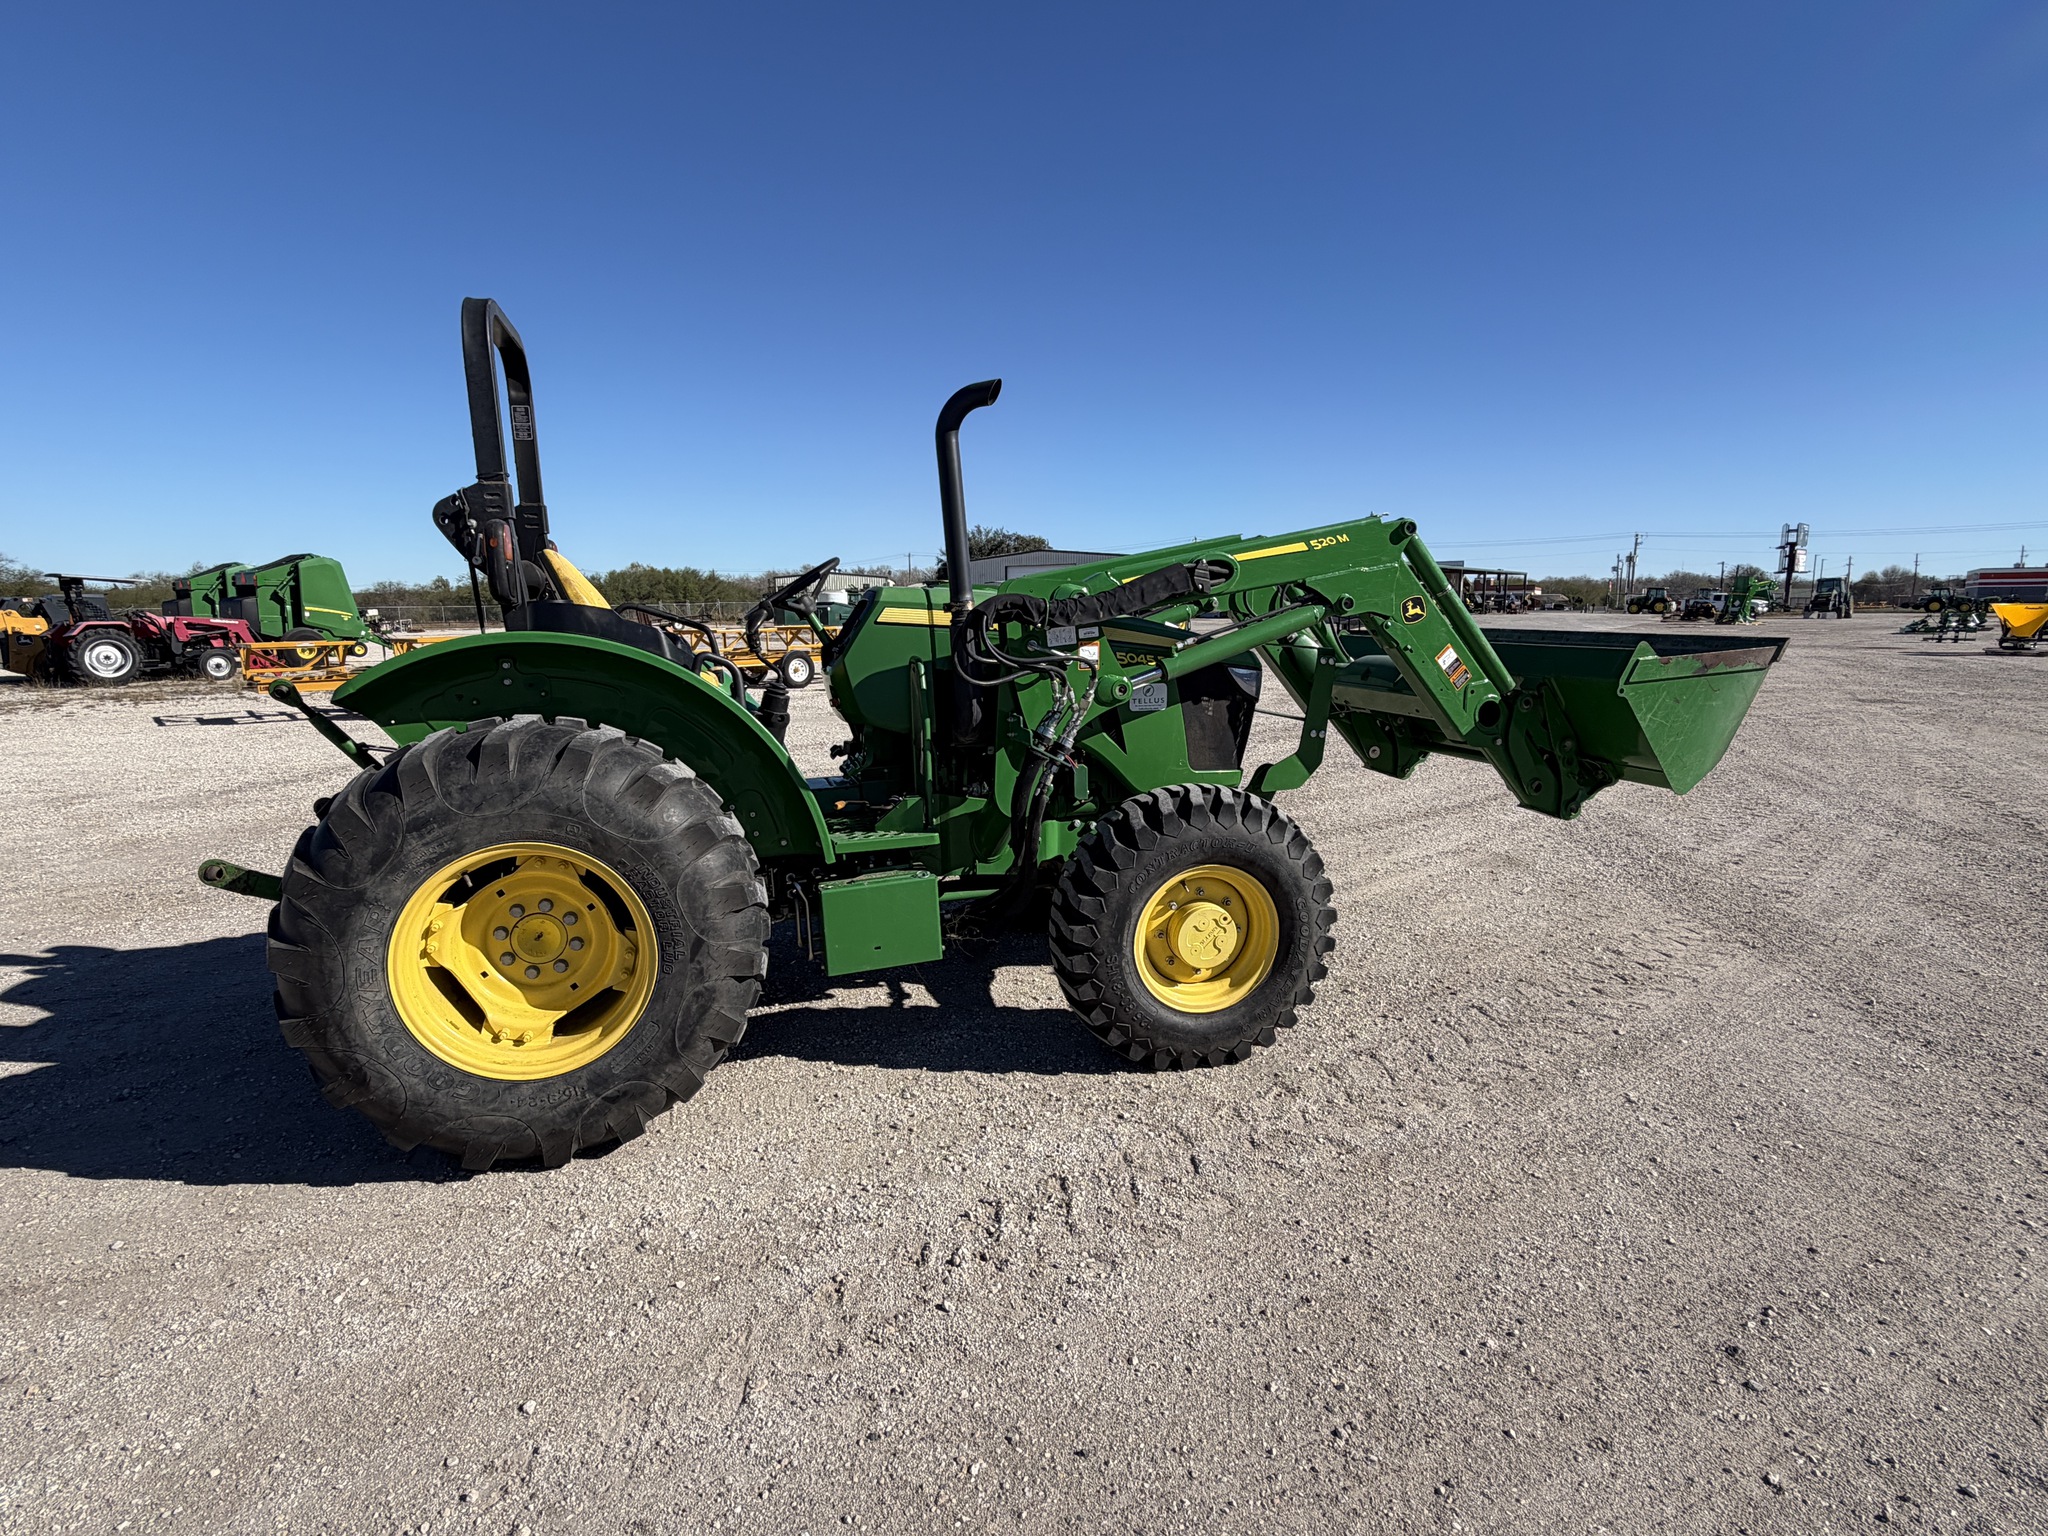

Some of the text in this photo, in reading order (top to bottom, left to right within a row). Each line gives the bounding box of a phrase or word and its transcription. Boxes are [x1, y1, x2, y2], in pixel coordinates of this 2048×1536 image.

[1310, 533, 1350, 550] 520 M
[1116, 651, 1165, 666] 5045
[635, 862, 686, 961] INDUSTRIAL
[662, 941, 674, 975] LUG
[1256, 895, 1310, 1022] GOODYEAR
[355, 903, 481, 1101] GOODYEAR
